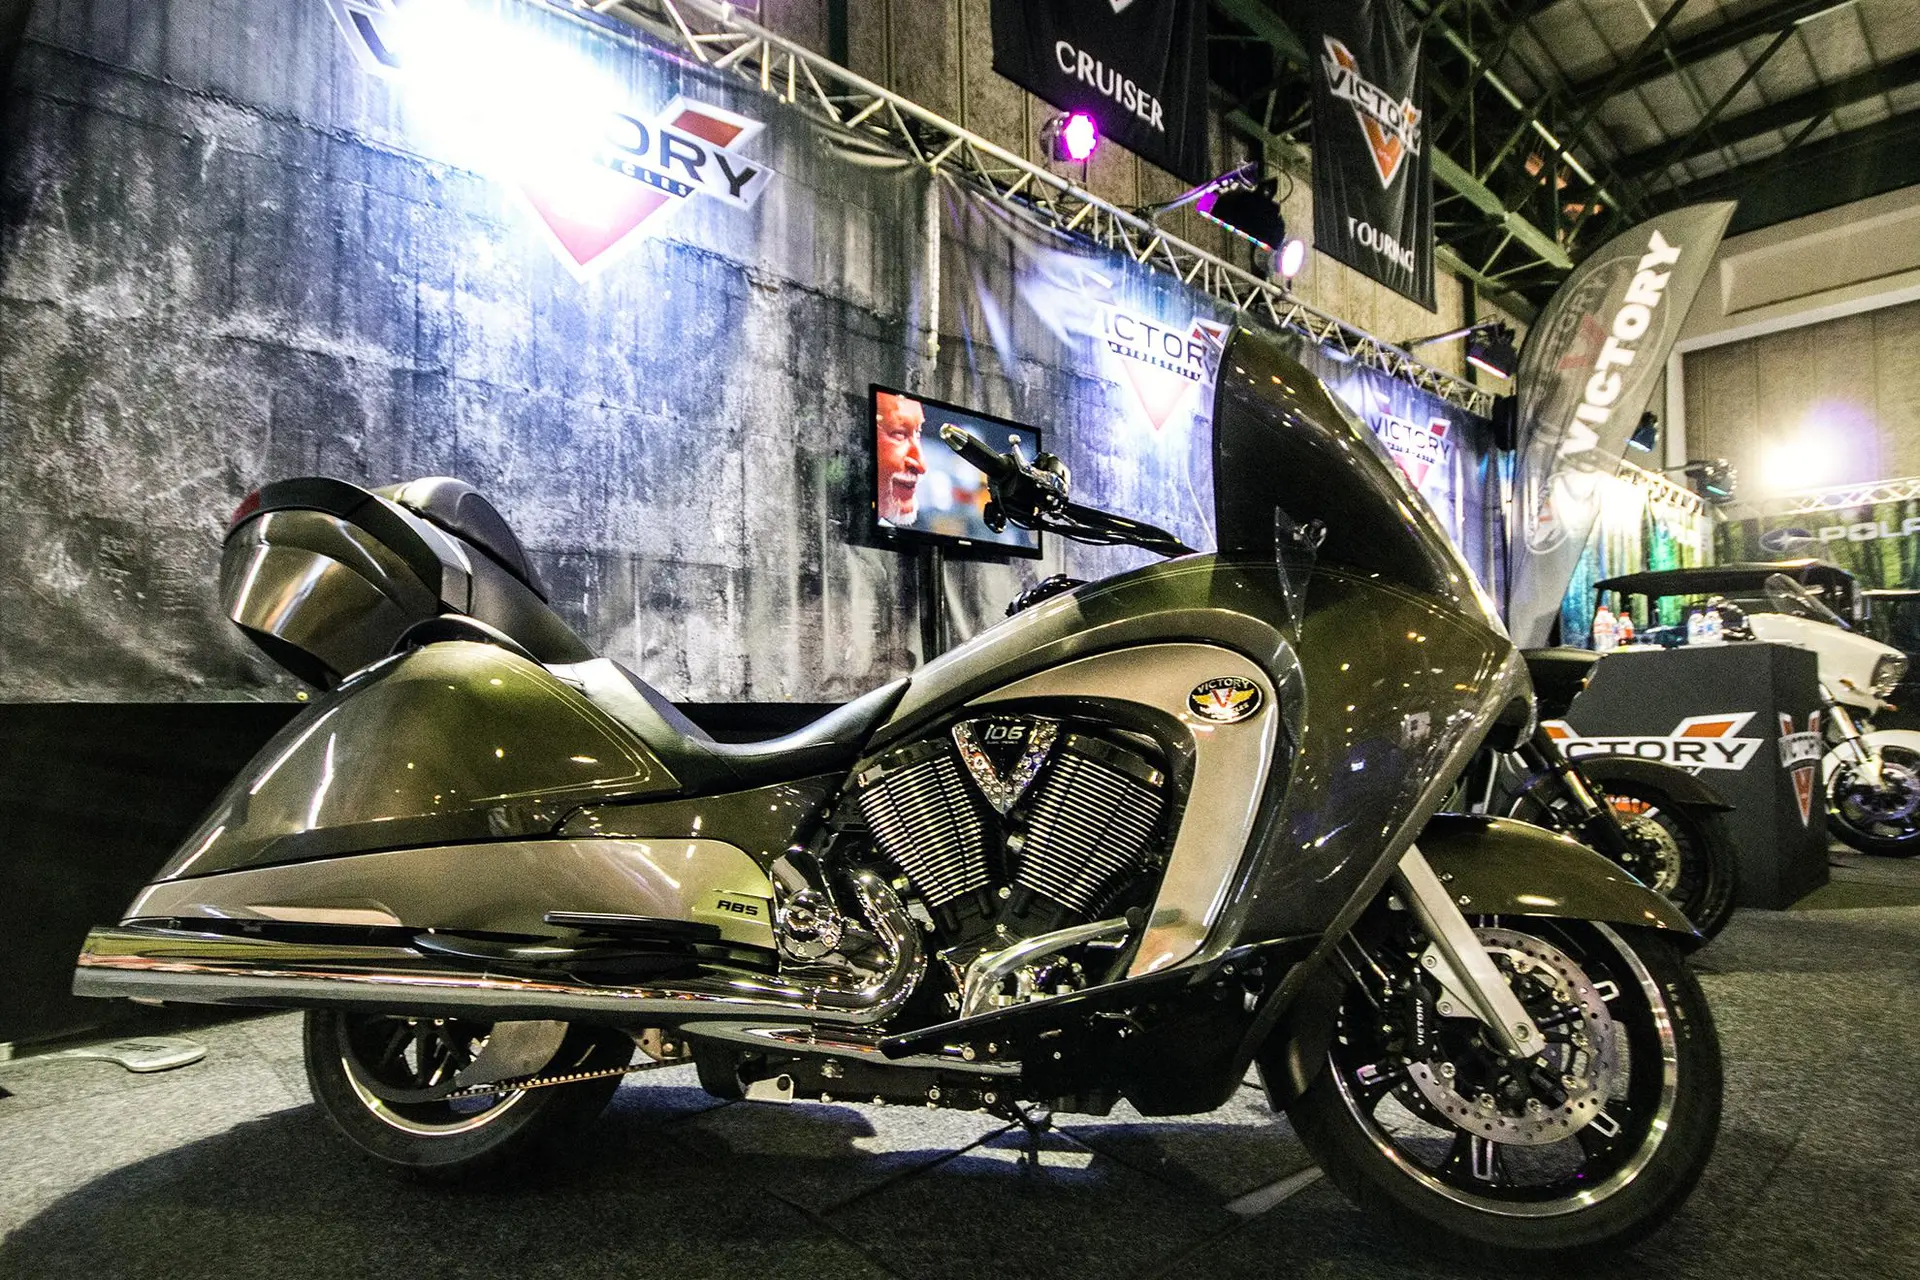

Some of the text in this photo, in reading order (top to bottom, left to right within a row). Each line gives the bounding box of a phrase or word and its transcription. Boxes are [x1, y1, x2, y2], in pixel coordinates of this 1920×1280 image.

[1056, 41, 1165, 132] CRUISER
[1326, 67, 1421, 152] VICTO
[1103, 308, 1217, 384] ICTORY
[1556, 229, 1681, 458] VICTORY
[1371, 416, 1450, 460] VICTORY
[1197, 678, 1250, 694] VICTORY
[984, 723, 1027, 740] 106
[1564, 741, 1749, 763] CTORY
[717, 900, 758, 916] ABS
[1416, 998, 1425, 1046] VICTORY
